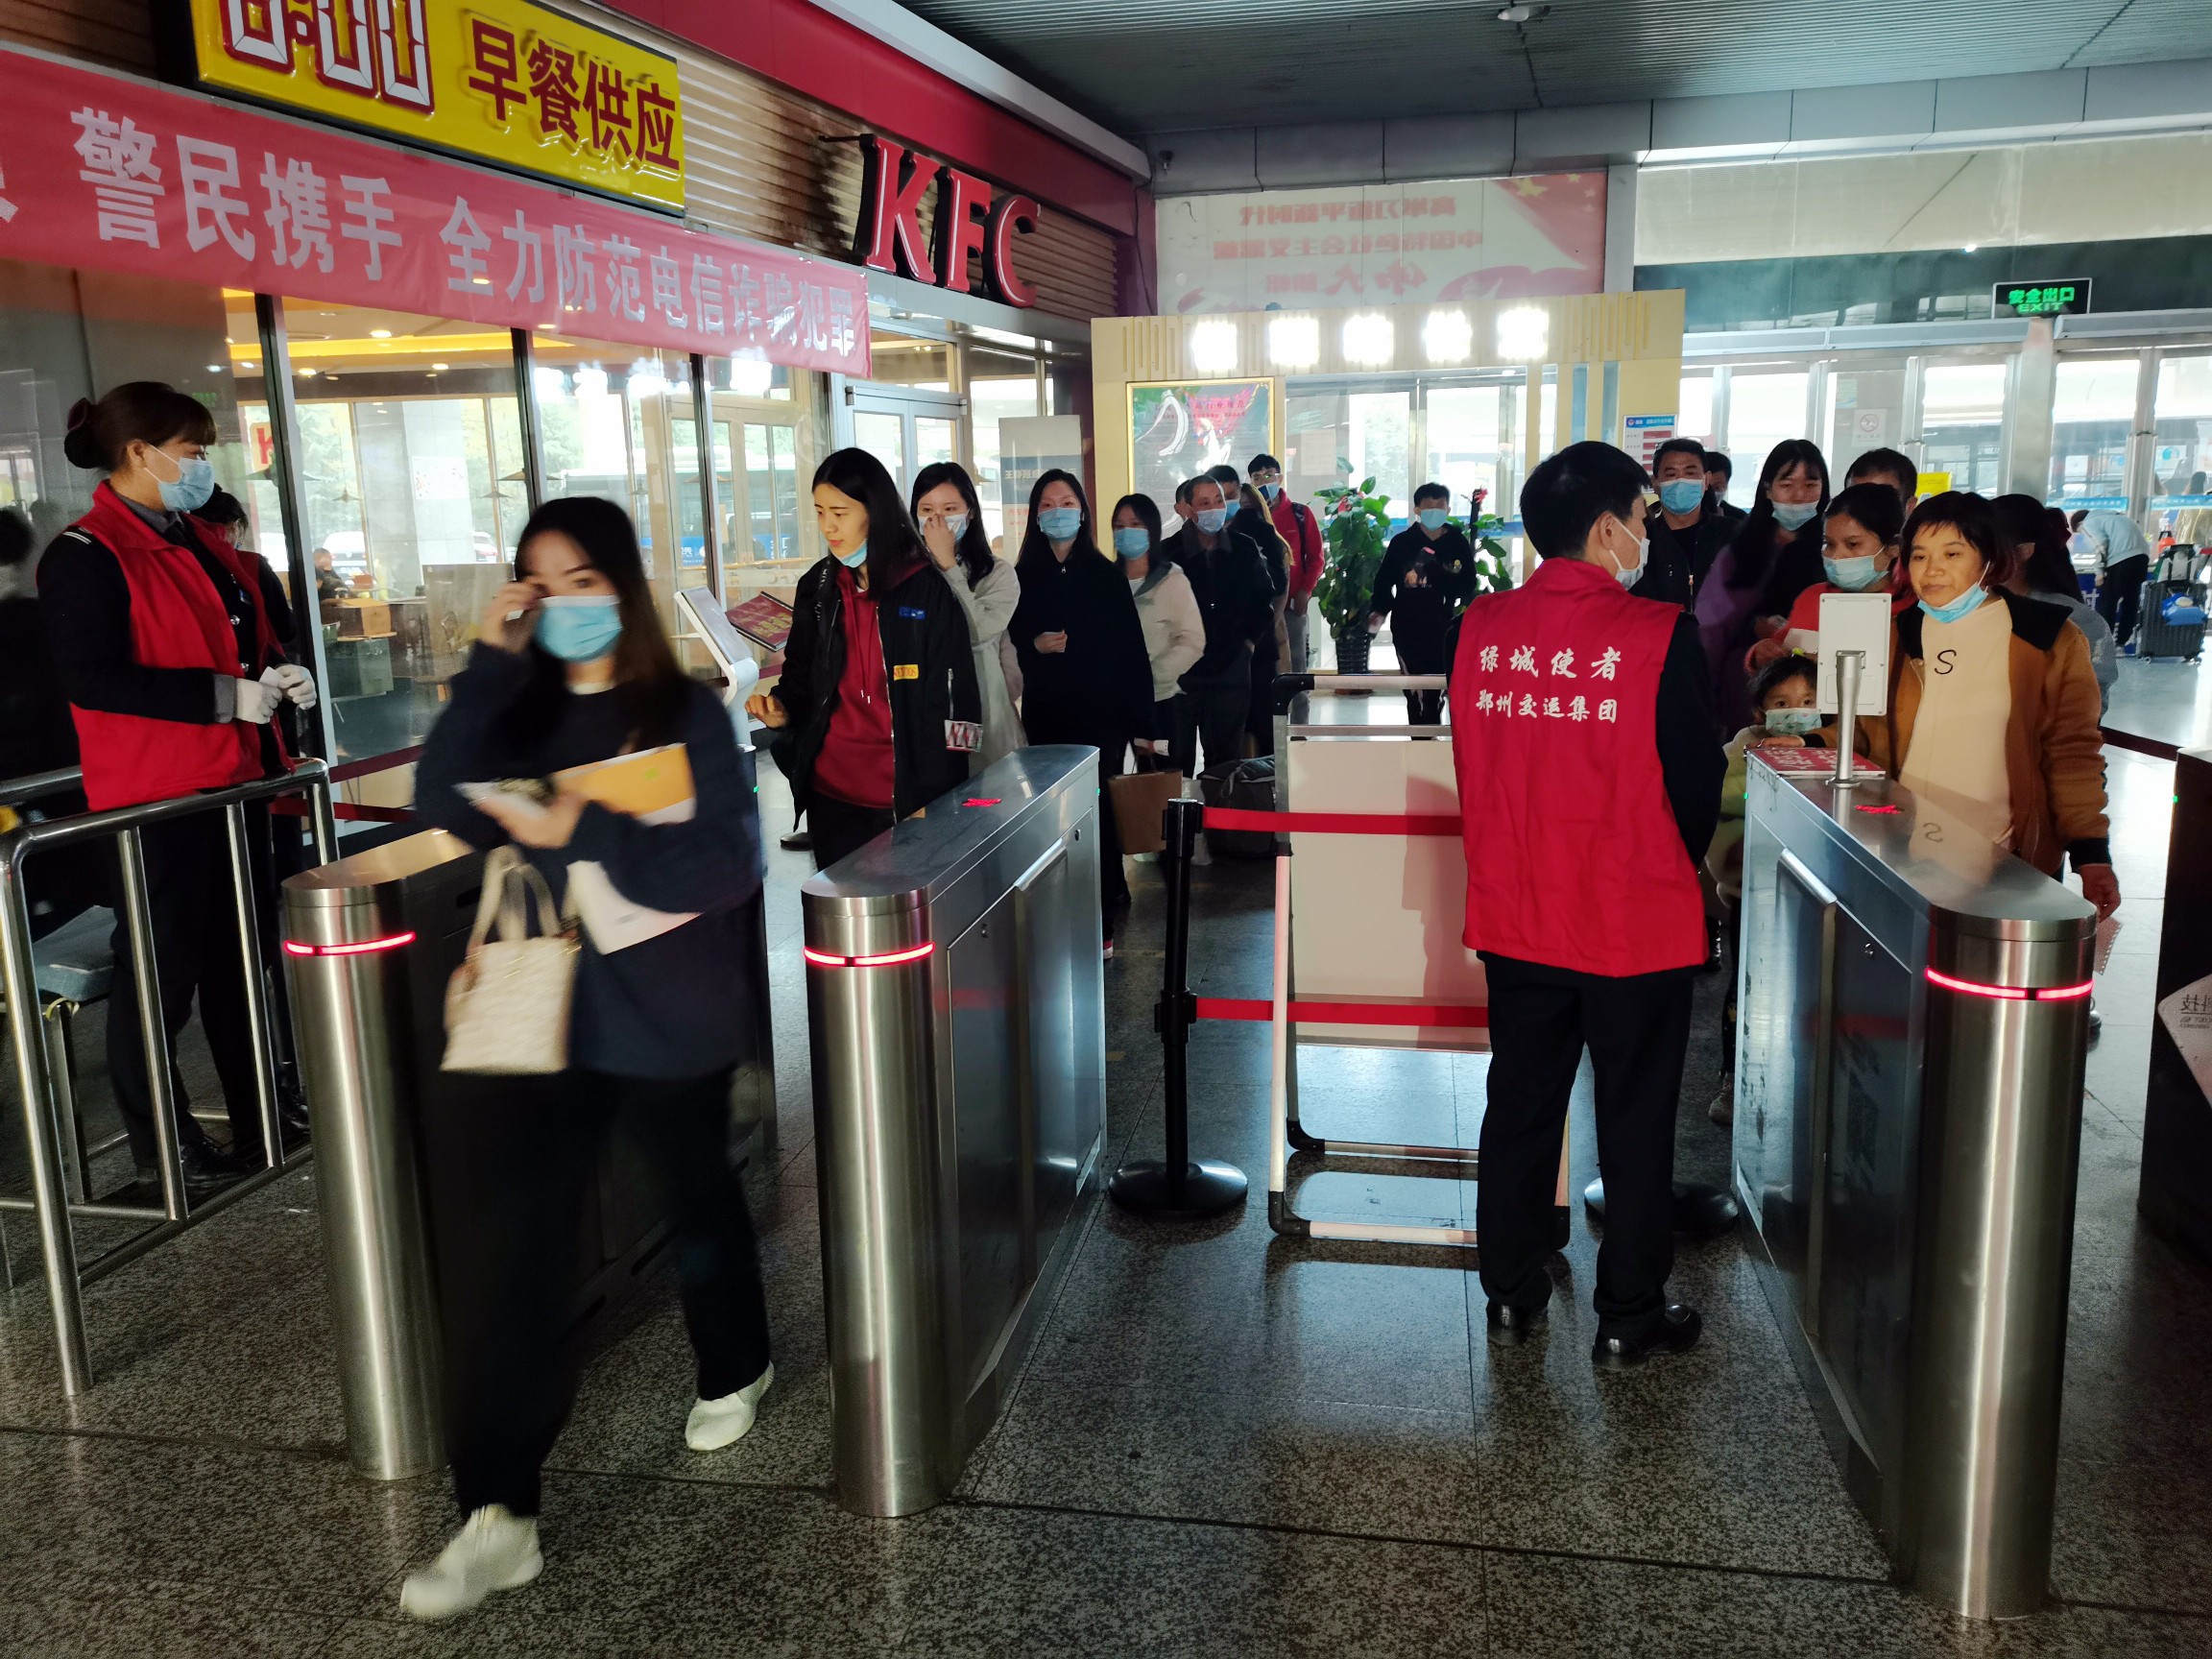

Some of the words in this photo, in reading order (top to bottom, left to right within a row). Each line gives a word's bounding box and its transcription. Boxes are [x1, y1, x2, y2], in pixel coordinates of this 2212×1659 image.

[468, 19, 681, 171] 早餐供应
[70, 107, 403, 282] 警民携手
[439, 195, 855, 357] 全力防范电信诈骗犯罪
[862, 133, 1042, 307] KFC
[2008, 286, 2076, 304] 安全出口
[2018, 302, 2063, 313] EXIT
[1479, 644, 1623, 682] 绿城使者
[1933, 647, 1959, 677] S
[1475, 687, 1619, 724] 郑州交运集团
